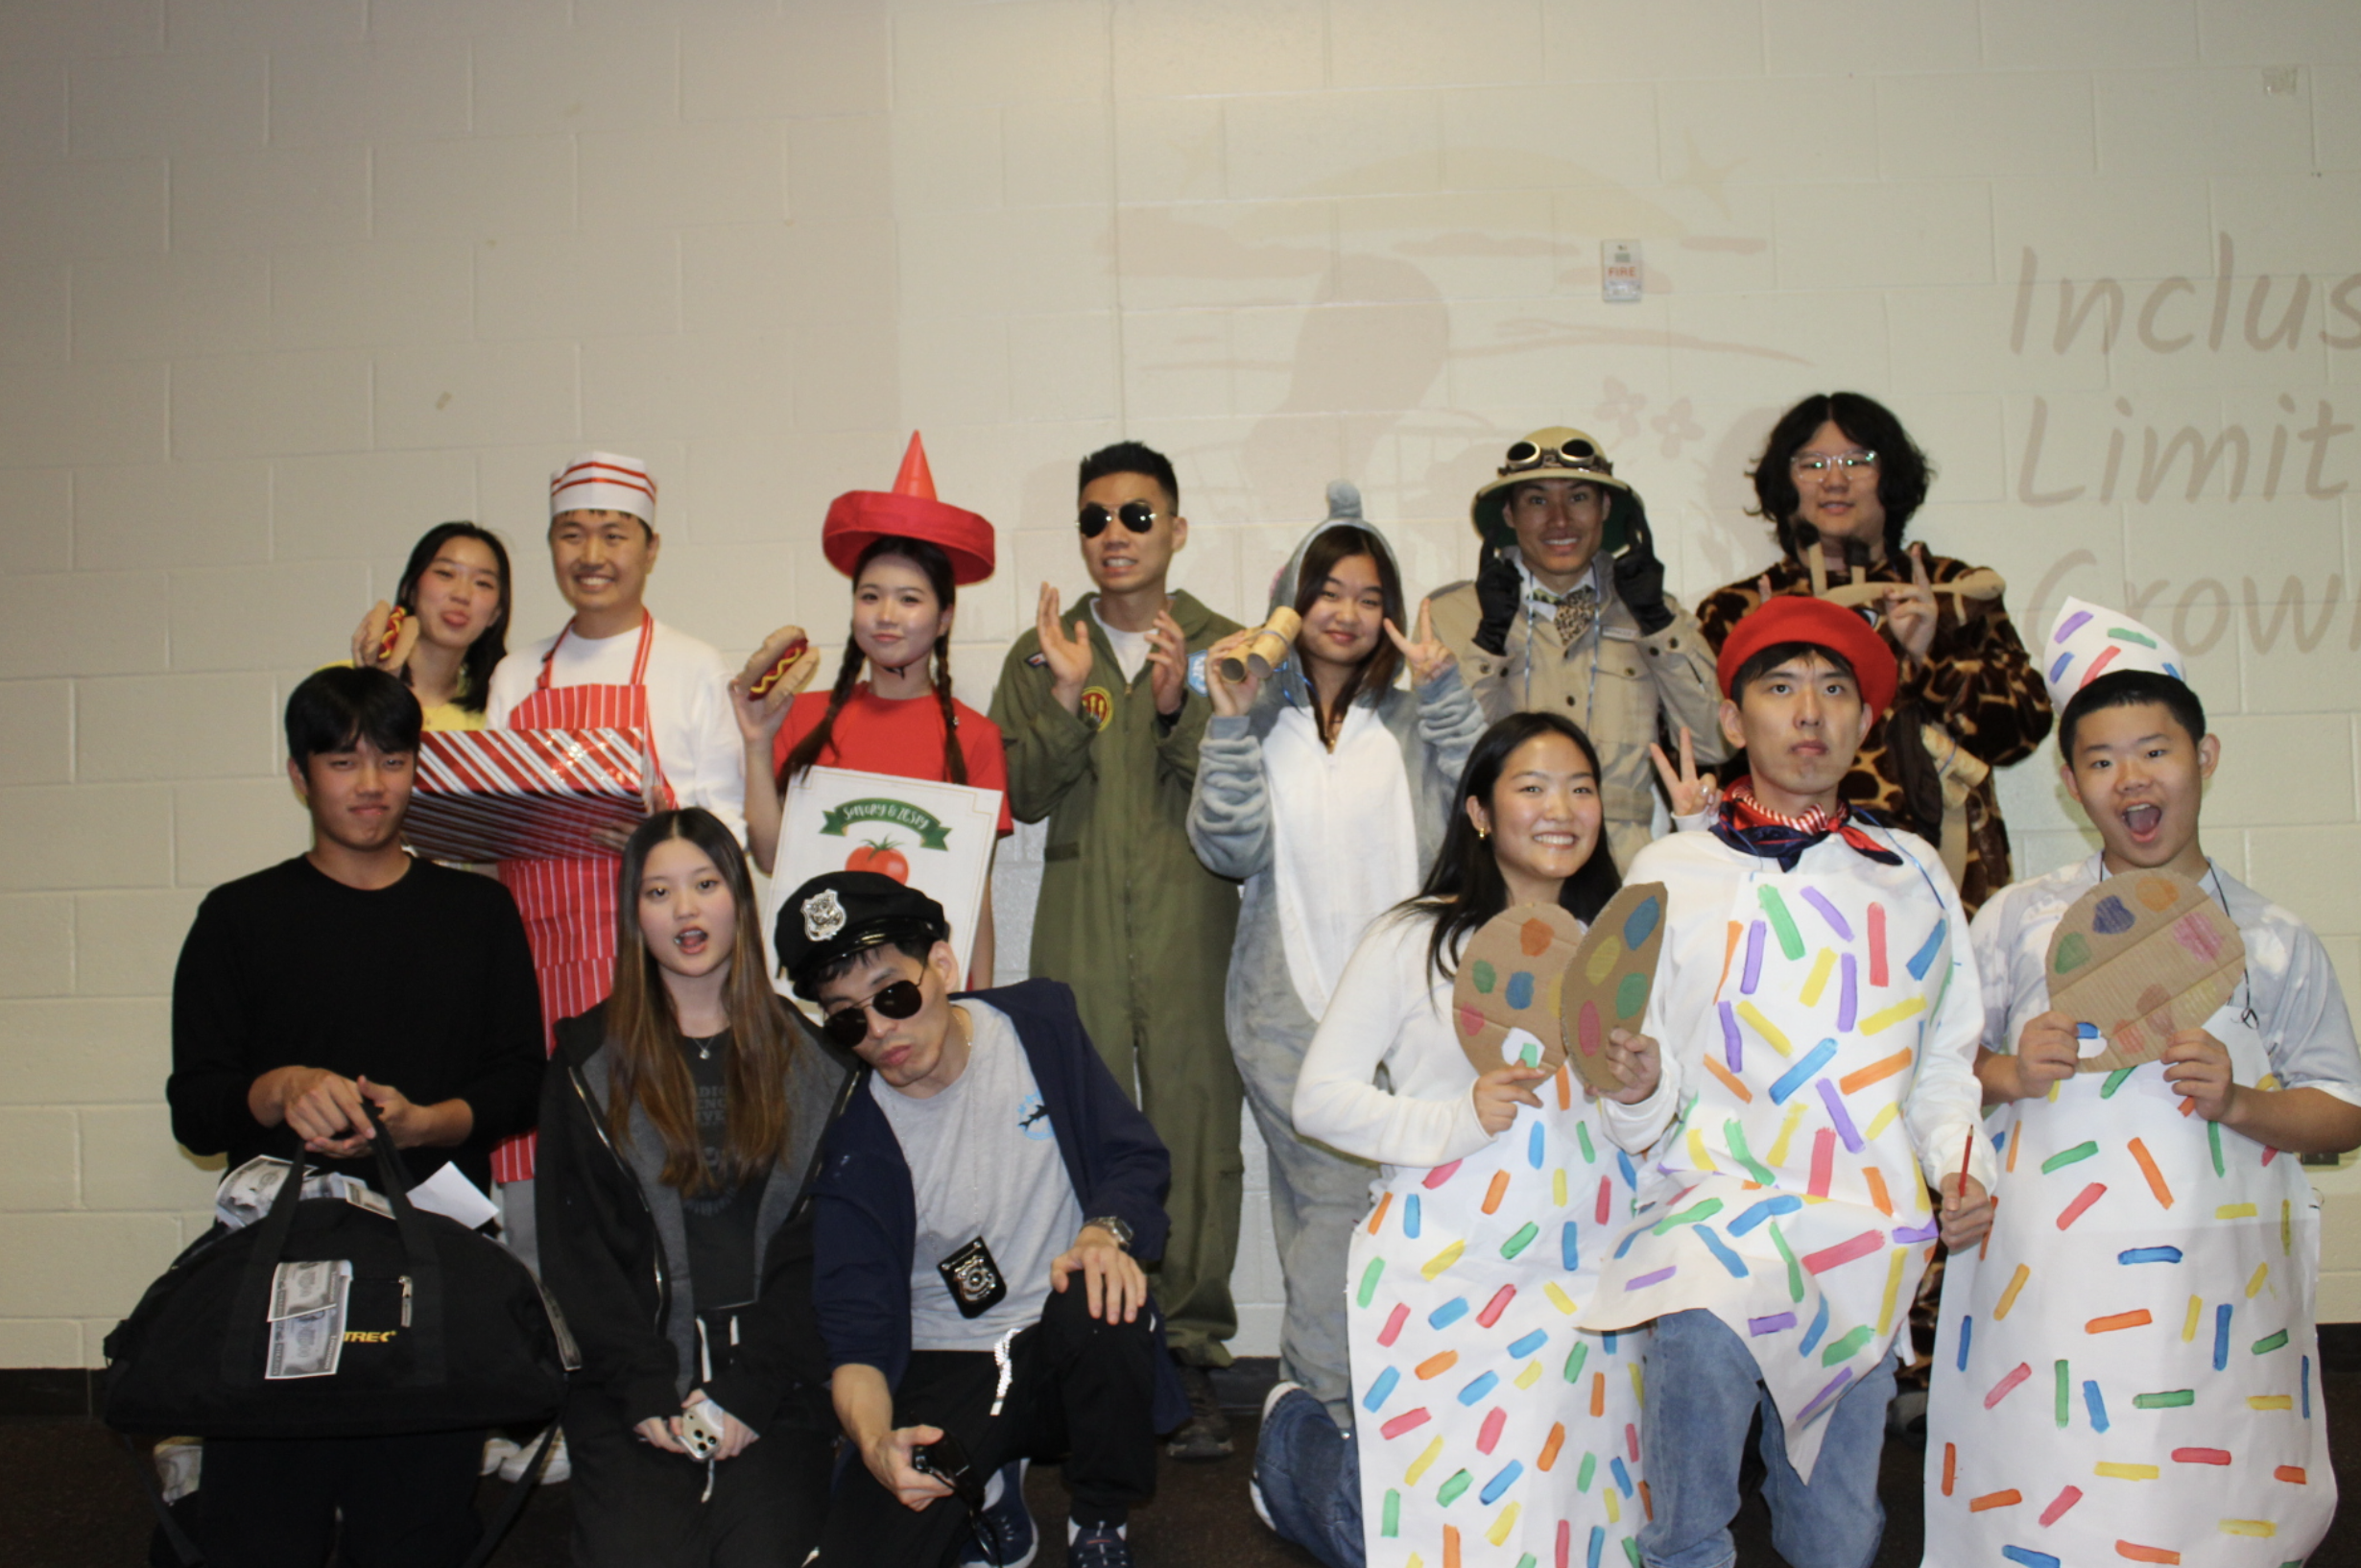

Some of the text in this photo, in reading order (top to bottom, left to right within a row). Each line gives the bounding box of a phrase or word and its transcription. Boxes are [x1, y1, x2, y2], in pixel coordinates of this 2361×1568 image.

[1609, 267, 1636, 276] FIRE
[2017, 392, 2354, 507] Limit
[2022, 548, 2361, 660] row
[888, 804, 897, 817] &
